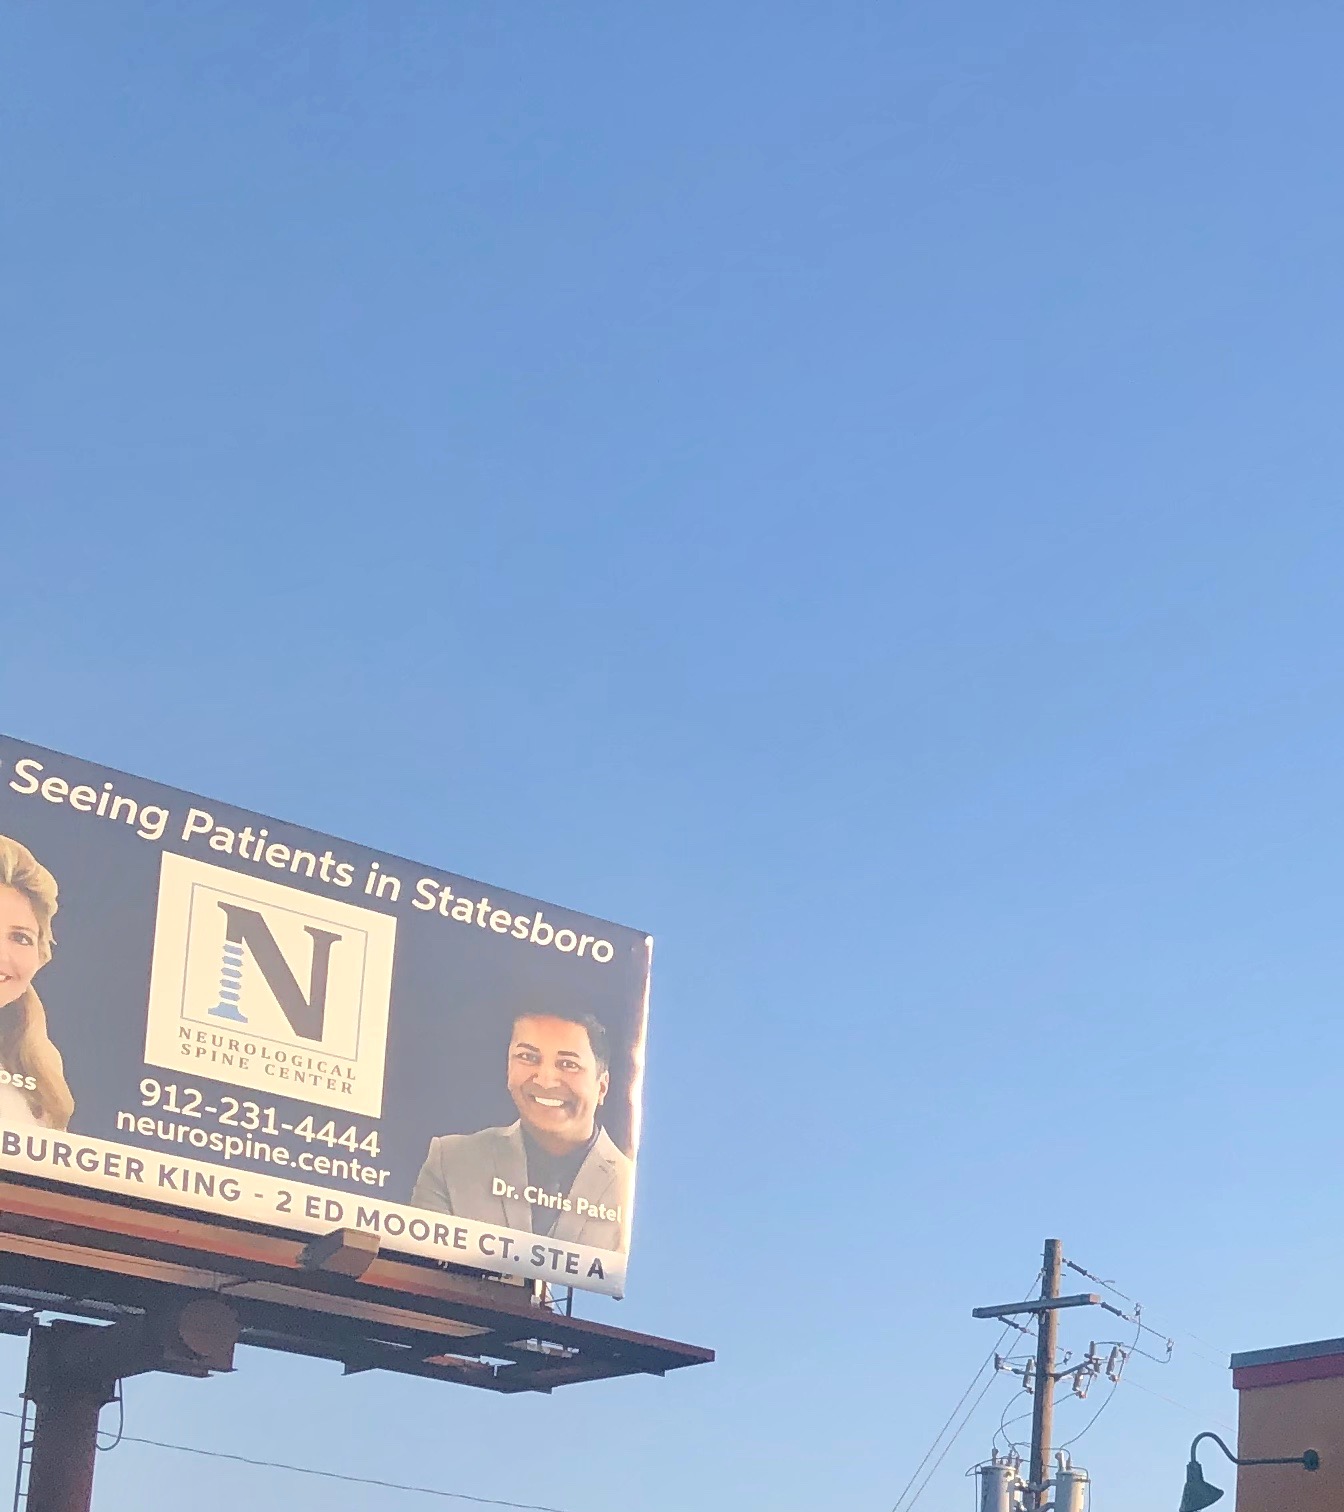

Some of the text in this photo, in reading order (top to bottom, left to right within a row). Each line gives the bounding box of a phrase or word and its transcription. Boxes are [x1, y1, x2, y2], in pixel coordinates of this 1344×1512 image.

[9, 758, 614, 963] Seeing Patients in Statesboro
[178, 1026, 357, 1081] NEUROLOGICAL
[180, 1043, 353, 1095] SPINE CENTER
[115, 1110, 391, 1188] neurospine.center
[139, 1077, 381, 1158] 912-231-4444
[2, 1130, 145, 1183] BURGER
[158, 1164, 241, 1202] KING
[275, 1190, 293, 1213] 2
[304, 1195, 344, 1222] ED
[356, 1206, 468, 1250] MOORE
[478, 1233, 520, 1262] CT.
[530, 1244, 580, 1275] STE
[586, 1257, 606, 1280] A
[492, 1177, 623, 1224] Dr. Chris Patel
